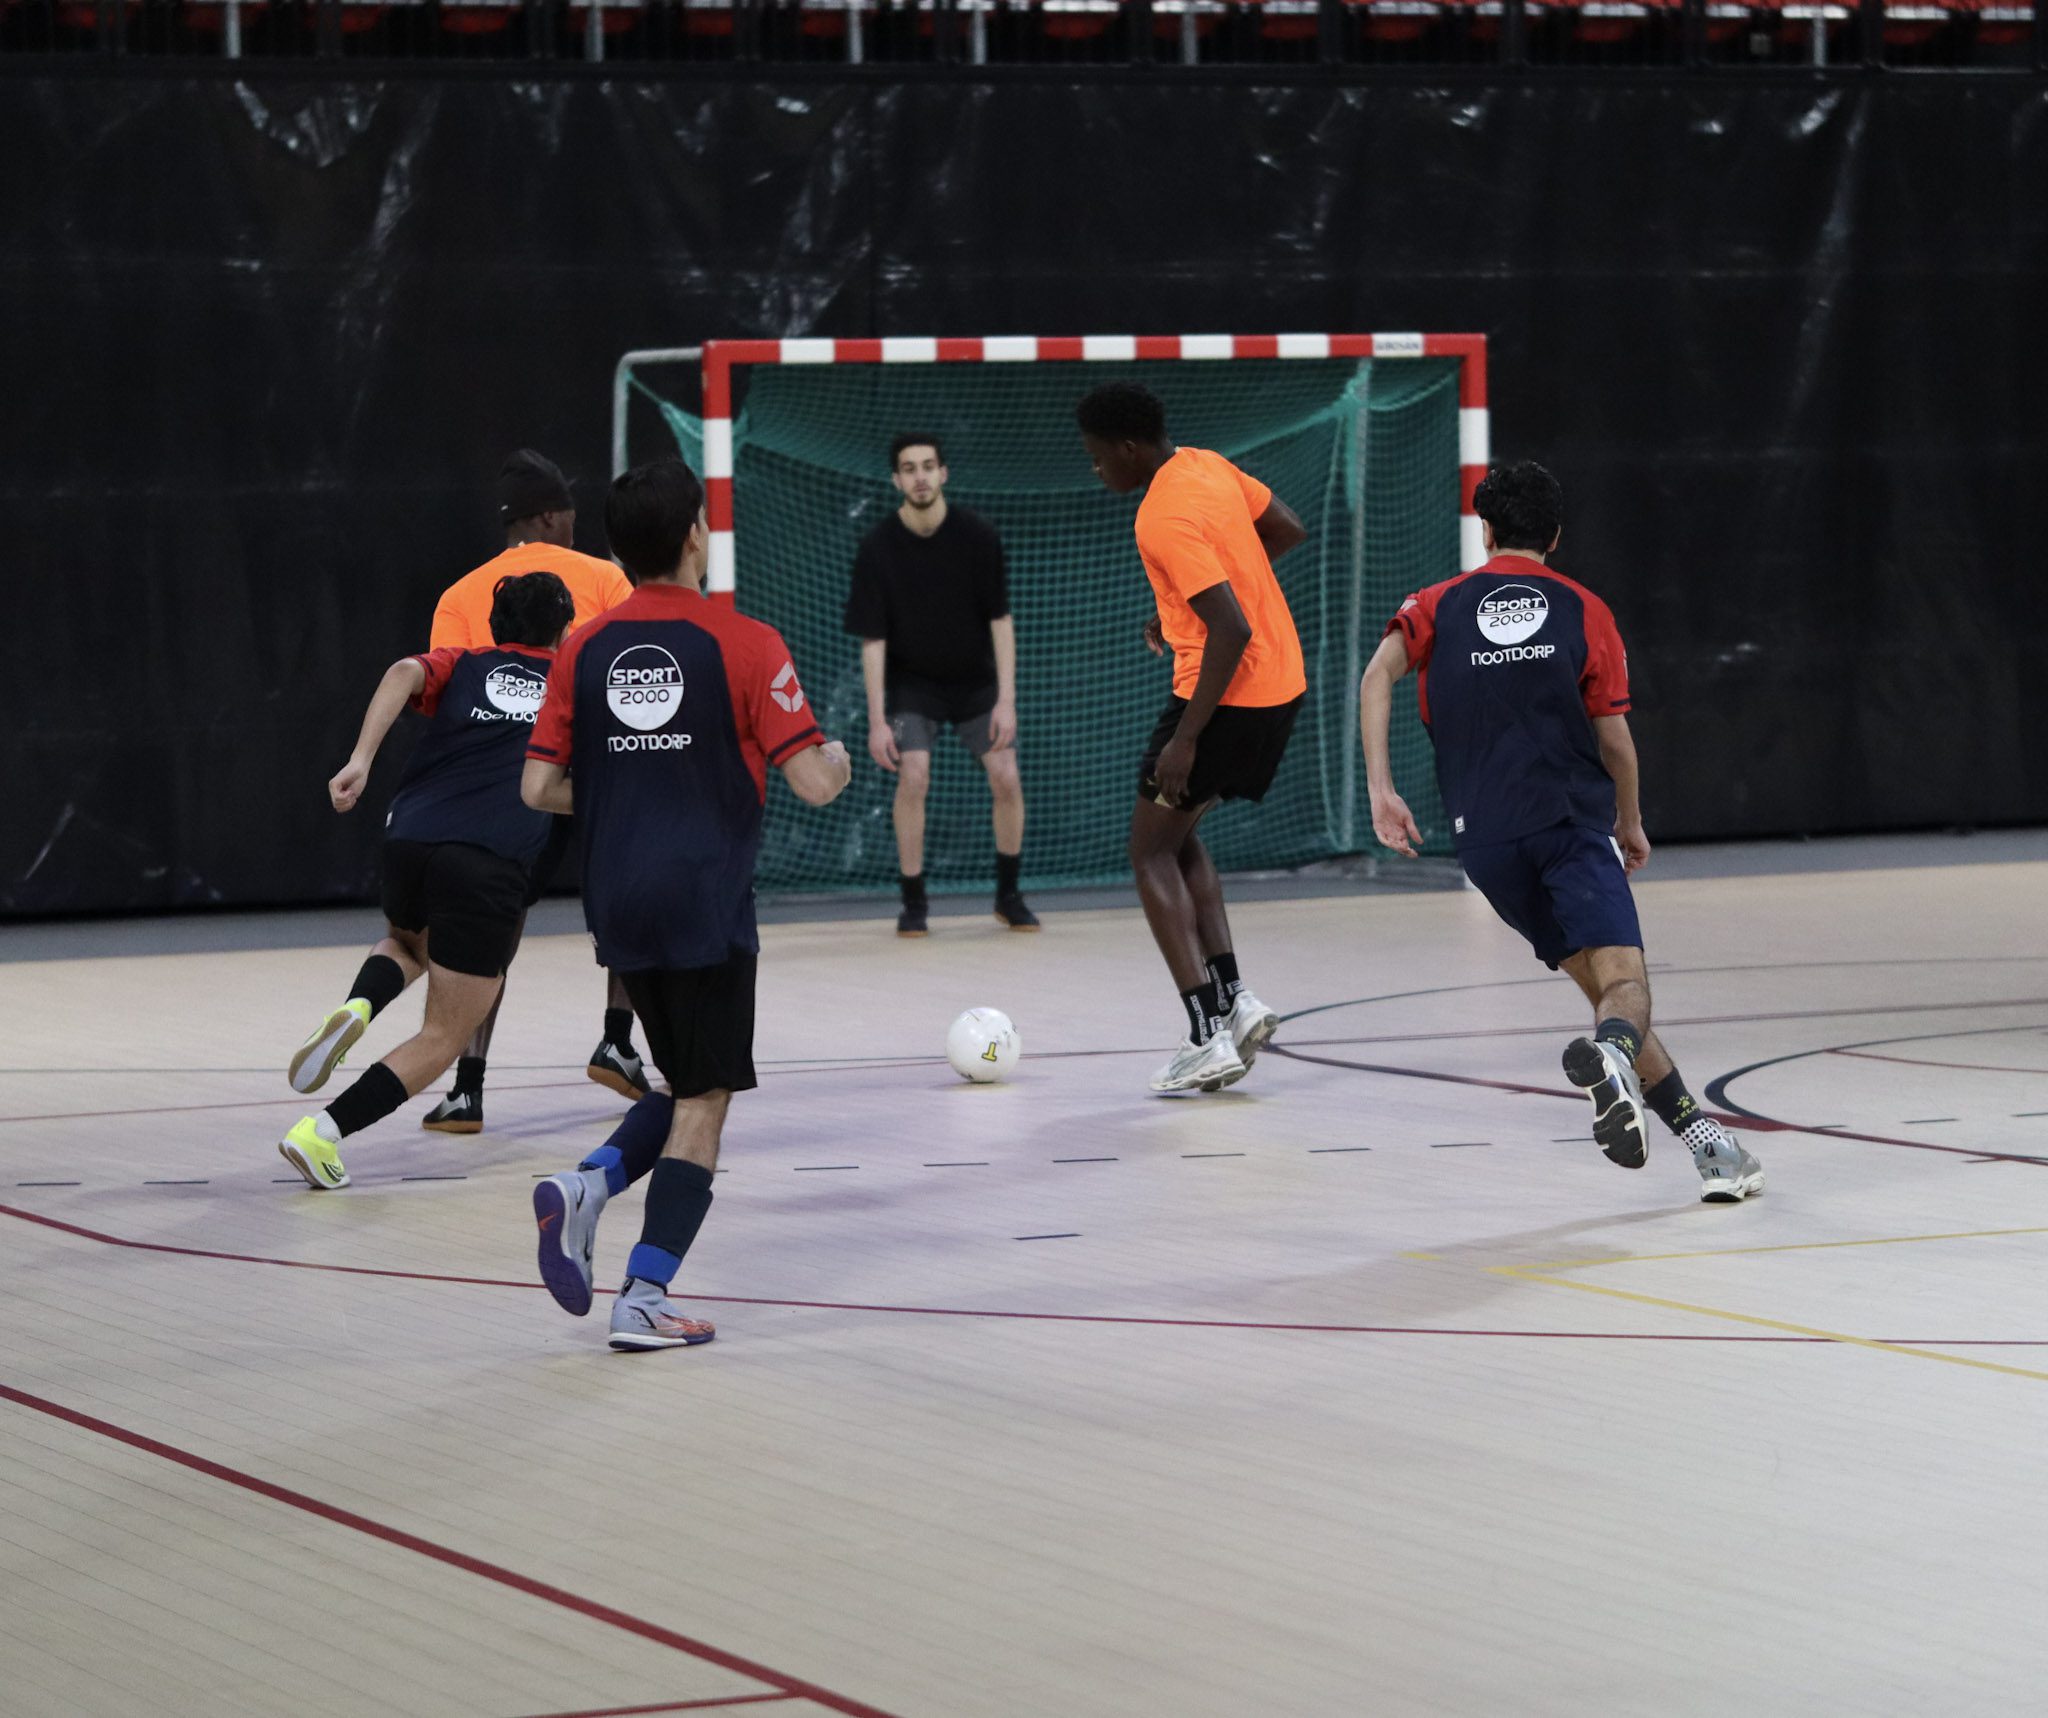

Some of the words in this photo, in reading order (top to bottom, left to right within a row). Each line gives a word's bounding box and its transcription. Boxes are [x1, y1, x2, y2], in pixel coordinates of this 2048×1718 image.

[1484, 597, 1543, 613] SPORT
[1489, 612, 1535, 627] 2000
[1471, 645, 1555, 665] NOOTDORP
[492, 672, 546, 691] SPORT
[611, 667, 676, 685] SPORT
[496, 684, 541, 700] 2000
[620, 689, 670, 704] 2000
